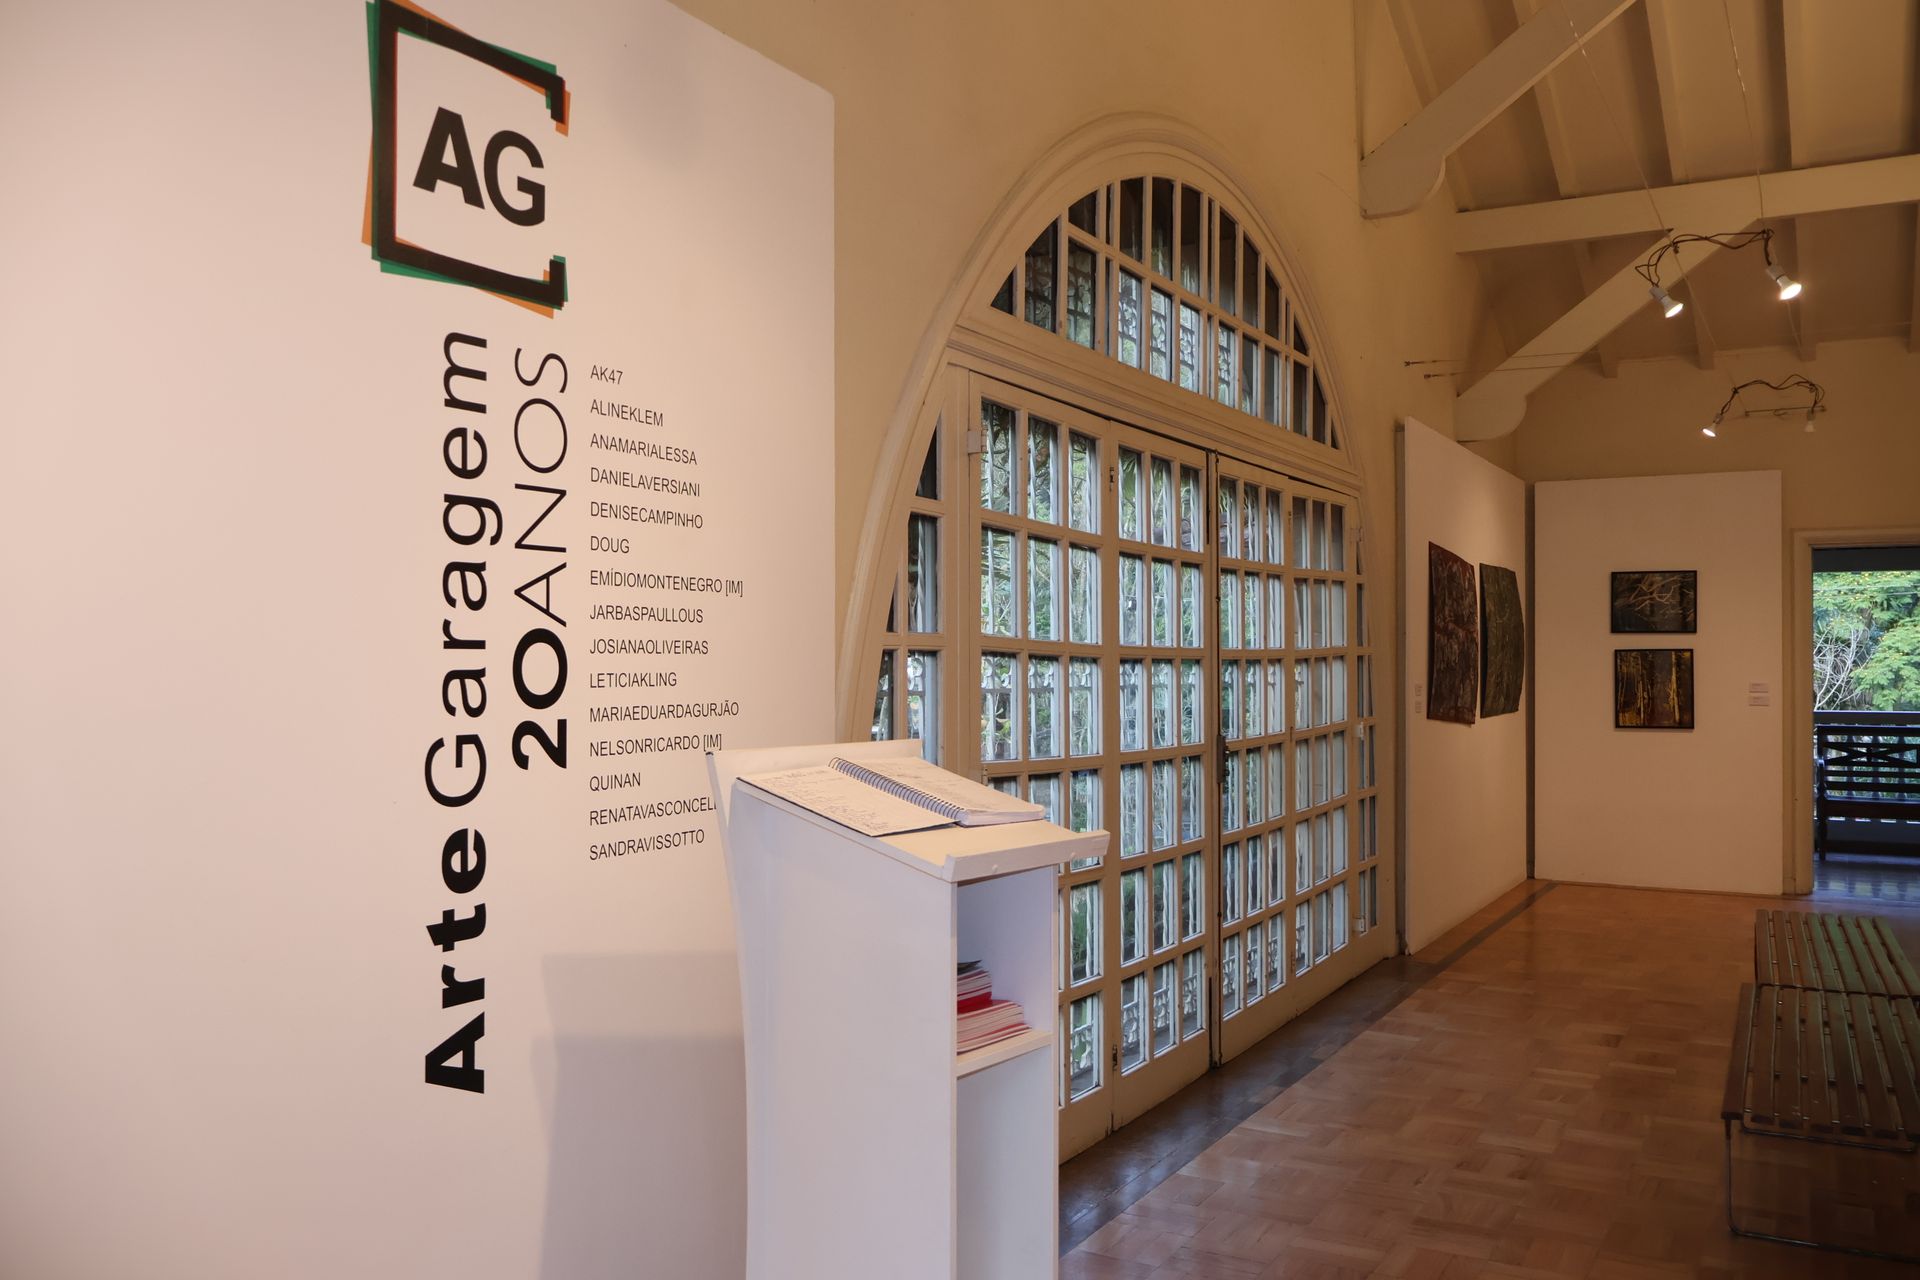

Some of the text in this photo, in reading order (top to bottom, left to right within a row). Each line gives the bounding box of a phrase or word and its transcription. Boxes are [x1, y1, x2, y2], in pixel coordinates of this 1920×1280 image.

[413, 106, 546, 227] AG
[590, 364, 624, 385] AK47
[590, 398, 664, 428] ALINEKLEM
[590, 432, 698, 466] ANAMARIALESSA
[590, 466, 700, 498] DANIELAVERSIANI
[590, 501, 704, 529] DENISECAMPINHO
[590, 535, 630, 554] DOUG
[590, 567, 744, 598] EMÍDIOMONTENEGRO [IM]
[589, 604, 704, 624] JARBASPAULLOUS
[589, 638, 709, 655] JOSIANAOLIVEIRAS
[590, 671, 678, 689] LETICIAKLING
[590, 699, 740, 723] MARIAEDUARDAGURJÃO
[590, 733, 723, 758] NELSONRICARDO [IM]
[590, 772, 642, 792] QUINAN
[589, 796, 717, 827] RENATAVASCONCEL
[589, 828, 705, 861] SANDRAVISSOTTO
